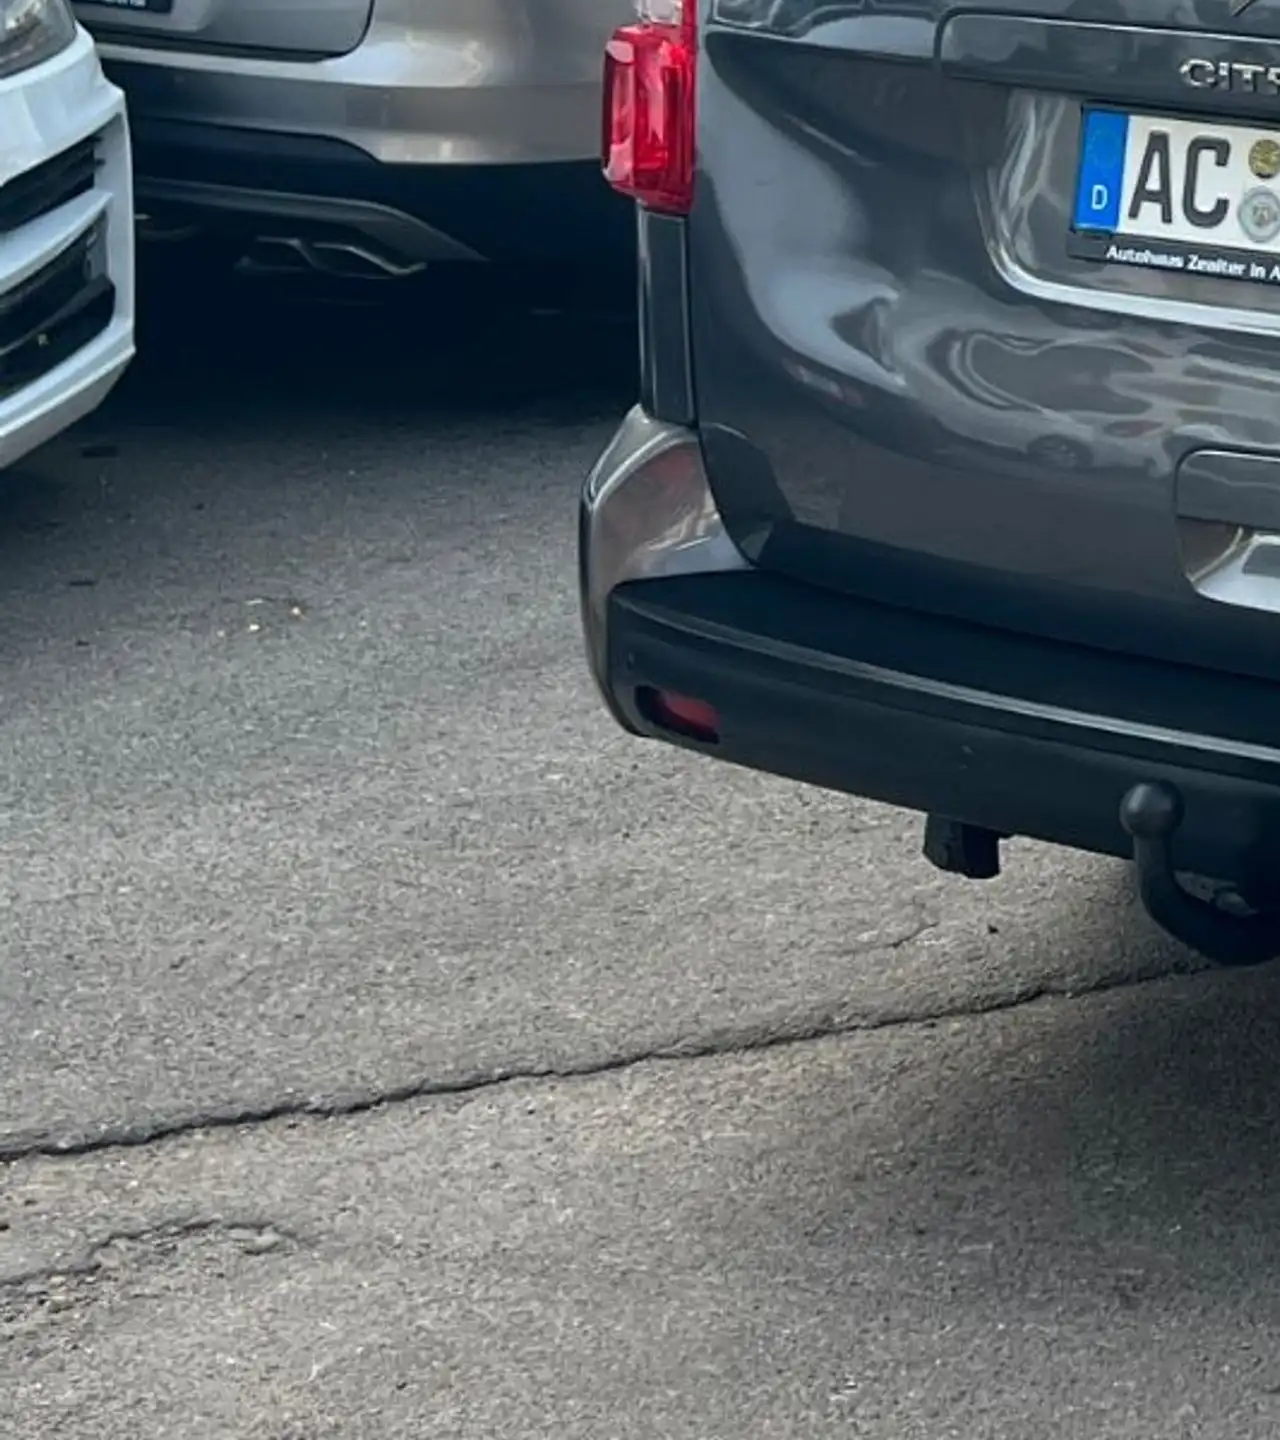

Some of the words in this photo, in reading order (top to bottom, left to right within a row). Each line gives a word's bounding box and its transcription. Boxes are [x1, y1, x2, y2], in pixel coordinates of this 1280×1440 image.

[1128, 130, 1231, 229] AC
[1091, 184, 1108, 211] D
[1106, 244, 1183, 269] Autohaus
